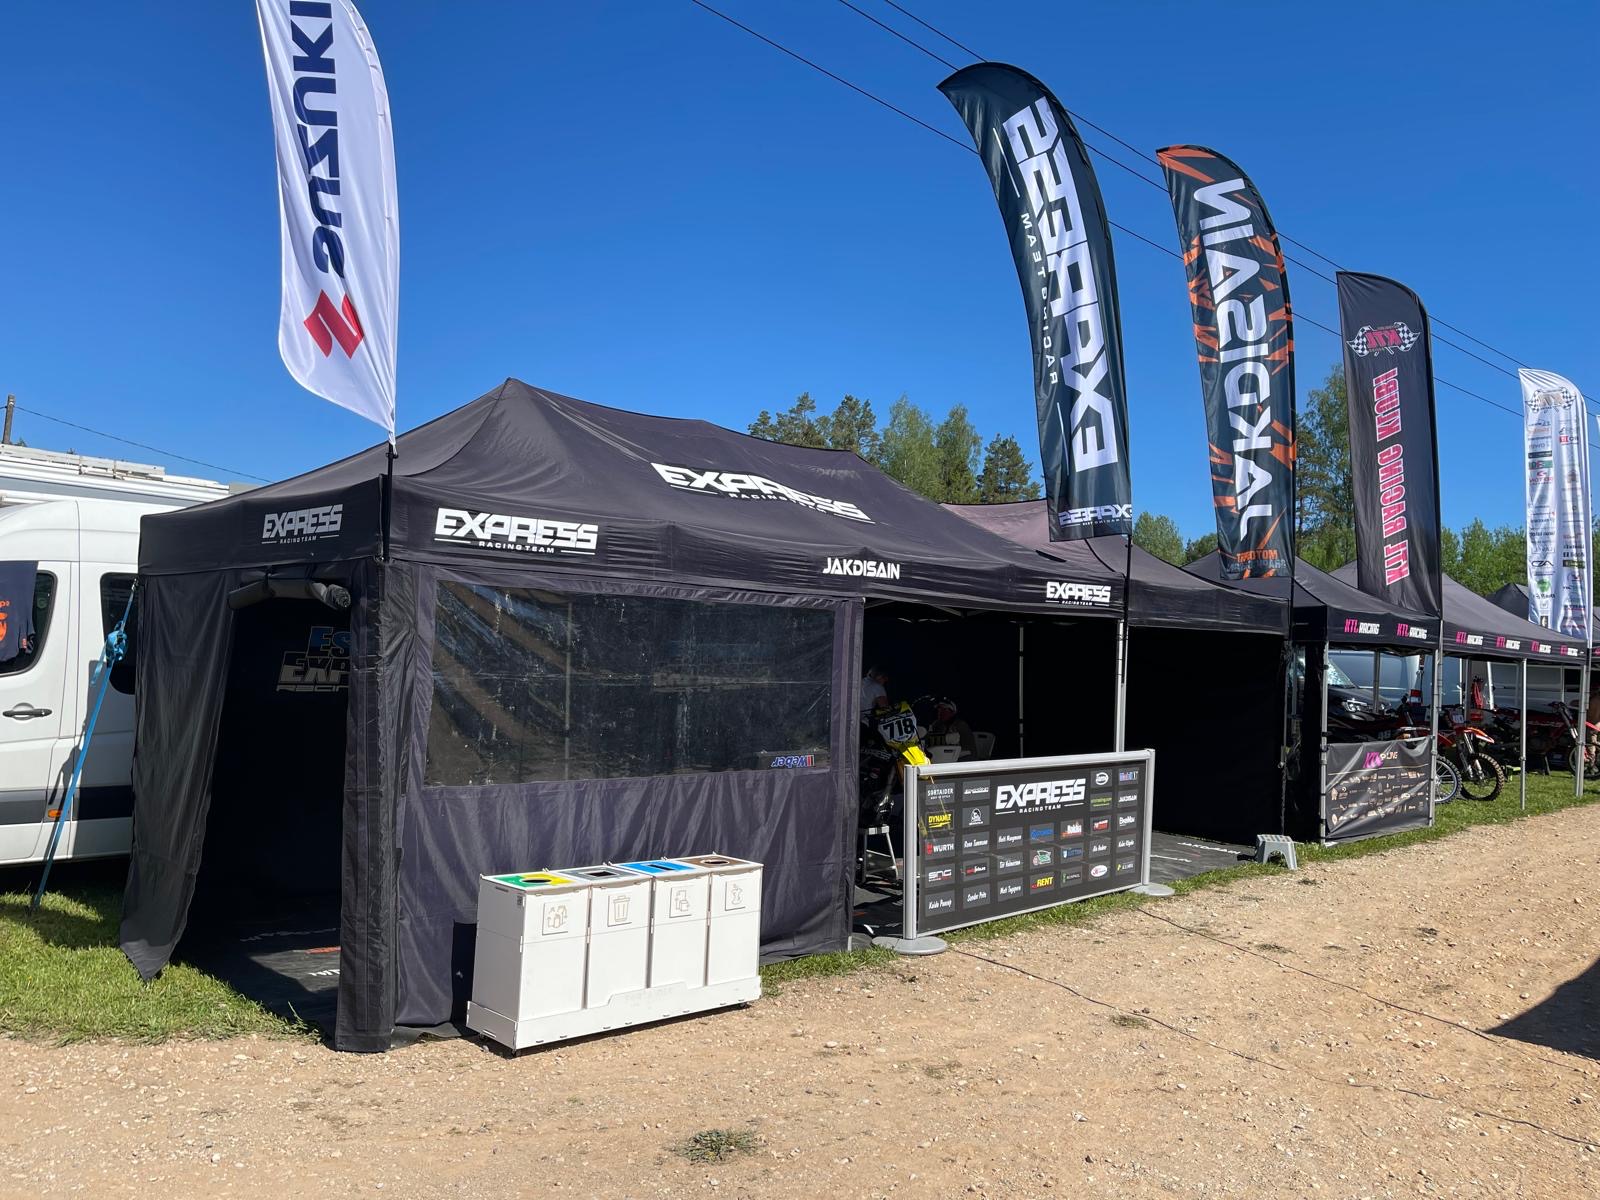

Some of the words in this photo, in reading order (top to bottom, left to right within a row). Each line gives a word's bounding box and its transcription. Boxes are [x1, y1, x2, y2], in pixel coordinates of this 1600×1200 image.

[650, 463, 872, 521] EXPRESS
[262, 504, 343, 539] EXPRESS
[435, 507, 599, 550] EXPRESS
[822, 557, 900, 580] JAKDISAIN
[1046, 581, 1111, 603] EXPRESS
[1345, 619, 1358, 633] KTL
[882, 718, 914, 740] 718
[771, 755, 808, 769] Weber
[996, 778, 1086, 809] EXPRESS
